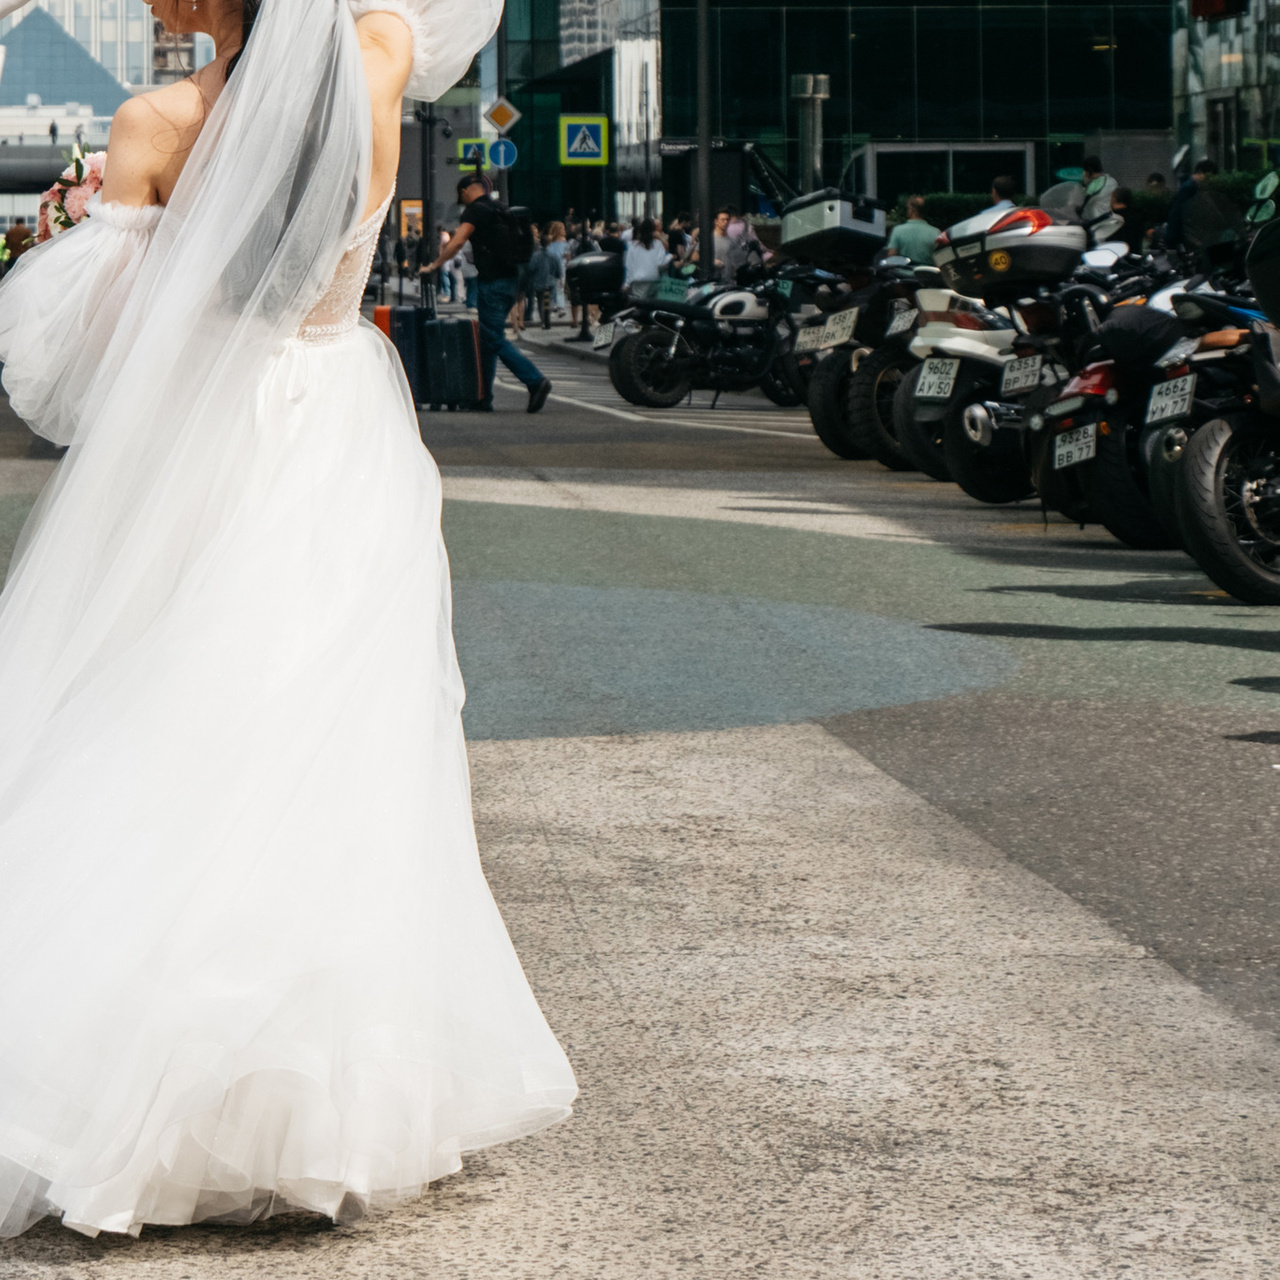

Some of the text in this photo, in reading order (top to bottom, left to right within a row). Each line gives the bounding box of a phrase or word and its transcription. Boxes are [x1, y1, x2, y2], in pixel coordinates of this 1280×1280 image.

[994, 255, 1007, 265] 40
[927, 361, 954, 375] 9602
[1009, 357, 1037, 372] 6353
[1024, 373, 1037, 385] 77
[936, 381, 951, 395] 50
[1172, 398, 1188, 413] 77
[1077, 445, 1092, 459] 77
